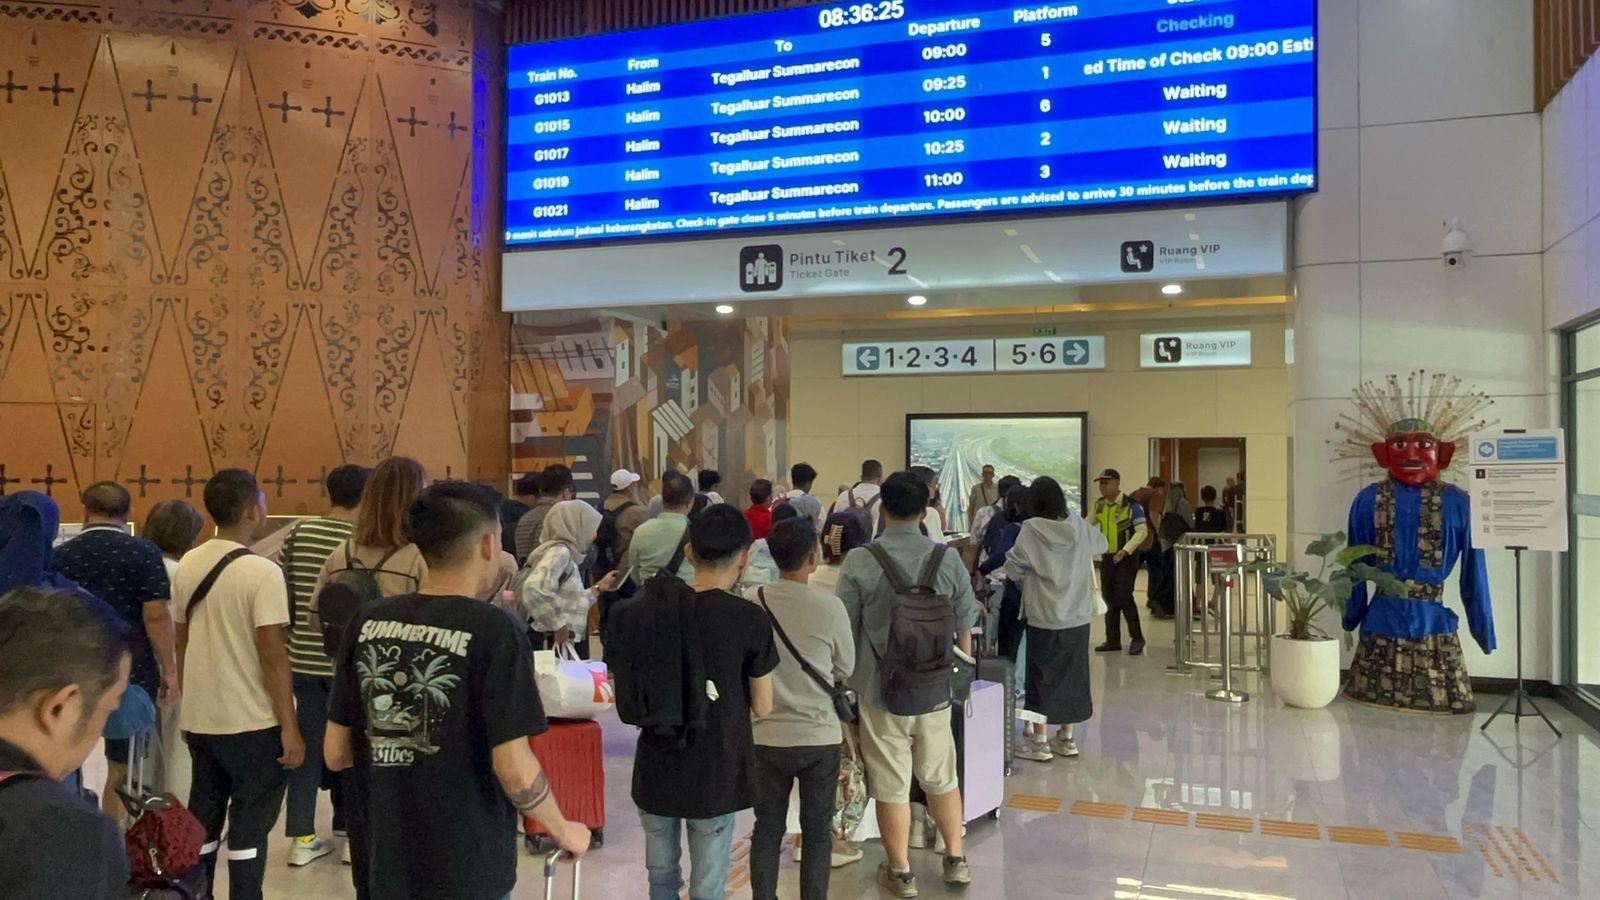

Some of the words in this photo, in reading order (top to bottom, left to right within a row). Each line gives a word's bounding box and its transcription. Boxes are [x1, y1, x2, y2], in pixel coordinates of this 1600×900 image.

[819, 0, 904, 28] 08:36:25
[1014, 6, 1077, 22] Platform
[909, 18, 980, 36] Departure
[1158, 16, 1233, 32] Checking
[775, 40, 792, 51] To
[1041, 33, 1051, 46] 5
[922, 44, 966, 59] 09:00
[1107, 58, 1146, 72] Time
[1150, 53, 1166, 67] of
[1170, 48, 1222, 65] Check
[1226, 41, 1278, 59] 09:00
[628, 59, 658, 70] From
[528, 70, 556, 82] Train
[558, 68, 577, 78] No.
[712, 69, 771, 85] Tegalluar
[773, 59, 859, 77] Summarecon
[1042, 67, 1048, 79] 1
[627, 81, 660, 94] Halim
[923, 76, 966, 91] 09:25
[535, 91, 569, 105] G1013
[1163, 84, 1226, 100] Waiting
[711, 100, 771, 115] Tegalluar
[773, 90, 859, 107] Summarecon
[1040, 99, 1050, 112] 6
[626, 110, 660, 123] Halim
[924, 108, 965, 123] 10:00
[535, 119, 570, 133] G1015
[711, 129, 770, 145] Tegalluar
[772, 121, 859, 138] Summarecon
[1163, 119, 1226, 134] Waiting
[1041, 132, 1050, 145] 2
[626, 140, 660, 152] Halim
[925, 140, 964, 154] 10:25
[535, 148, 569, 161] G1017
[1163, 153, 1226, 168] Waiting
[711, 160, 769, 175] Tegalluar
[772, 152, 859, 168] Summarecon
[626, 169, 659, 180] Halim
[1040, 165, 1050, 178] 3
[533, 176, 569, 189] G1019
[925, 172, 963, 186] 11:00
[710, 190, 769, 205] Tegalluar
[772, 183, 858, 199] Summarecon
[625, 198, 659, 210] Halim
[676, 216, 716, 228] Check-in
[718, 215, 739, 228] gate
[741, 214, 766, 223] close
[768, 212, 774, 221] 5
[776, 211, 816, 220] minutes
[818, 207, 852, 217] before
[854, 205, 878, 214] train
[880, 203, 934, 215] departure.
[938, 198, 998, 210] Passengers
[1021, 191, 1064, 203] advised
[1067, 191, 1080, 200] to
[1083, 189, 1116, 199] arrive
[1120, 187, 1134, 196] 30
[1137, 184, 1185, 195] minutes
[1189, 180, 1230, 191] before
[1233, 178, 1254, 188] the
[1258, 175, 1287, 186] train
[534, 205, 568, 217] G1021
[1159, 246, 1197, 256] Ruang
[1200, 244, 1221, 254] VIP
[790, 253, 831, 266] Pintu
[835, 249, 876, 263] Tiket
[887, 246, 907, 275] 2
[790, 269, 822, 279] Ticket
[825, 268, 849, 278] Gate
[1186, 342, 1217, 351] Ruang
[1219, 340, 1236, 349] VIP
[358, 619, 472, 658] SUMMERTIME
